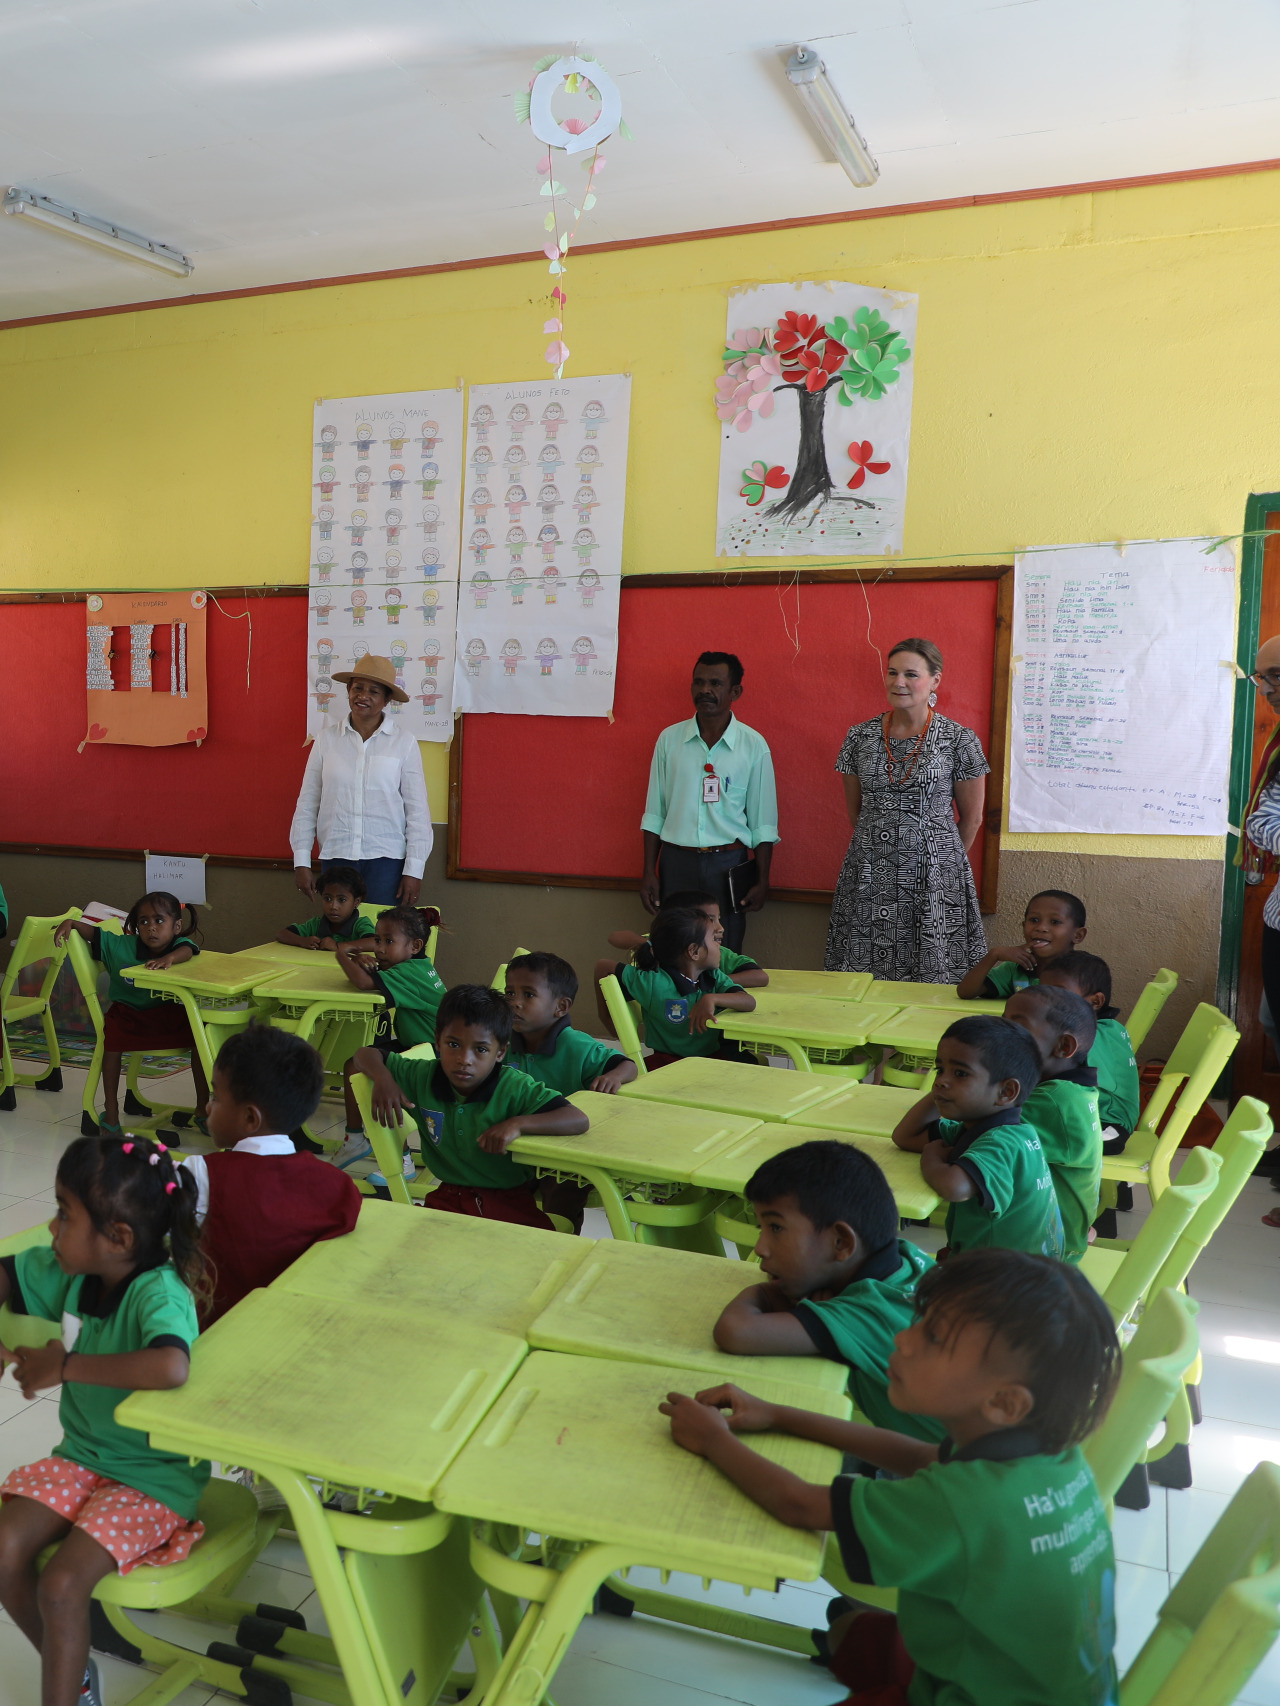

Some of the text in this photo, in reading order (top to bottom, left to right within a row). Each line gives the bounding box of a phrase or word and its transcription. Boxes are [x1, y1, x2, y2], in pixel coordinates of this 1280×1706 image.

[354, 408, 395, 423] ALUNOS
[1100, 571, 1130, 579] Tema
[1023, 1487, 1066, 1519] Ha'u
